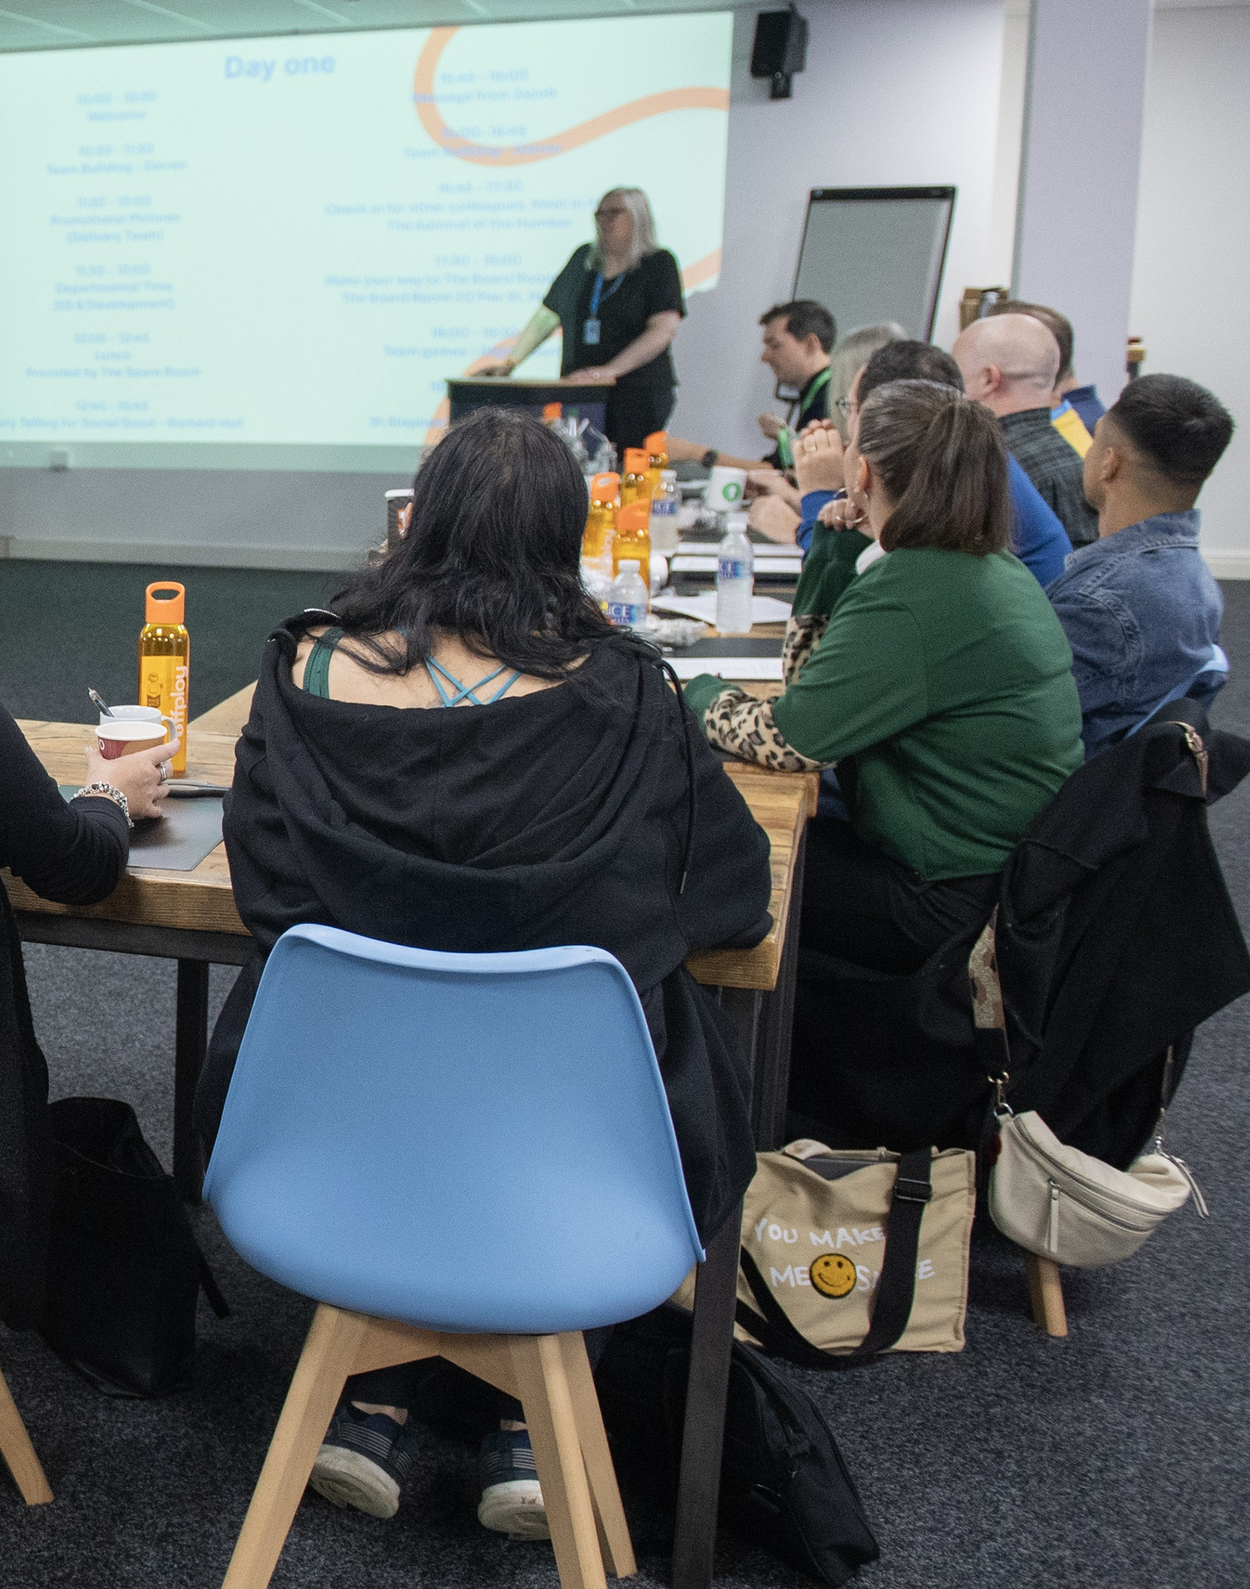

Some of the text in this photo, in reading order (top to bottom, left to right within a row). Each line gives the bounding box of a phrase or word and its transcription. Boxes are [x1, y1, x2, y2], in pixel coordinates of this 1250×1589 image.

[224, 53, 337, 83] Day one
[170, 665, 188, 737] offploy
[754, 1218, 886, 1249] YOU MAKE
[769, 1265, 811, 1288] ME
